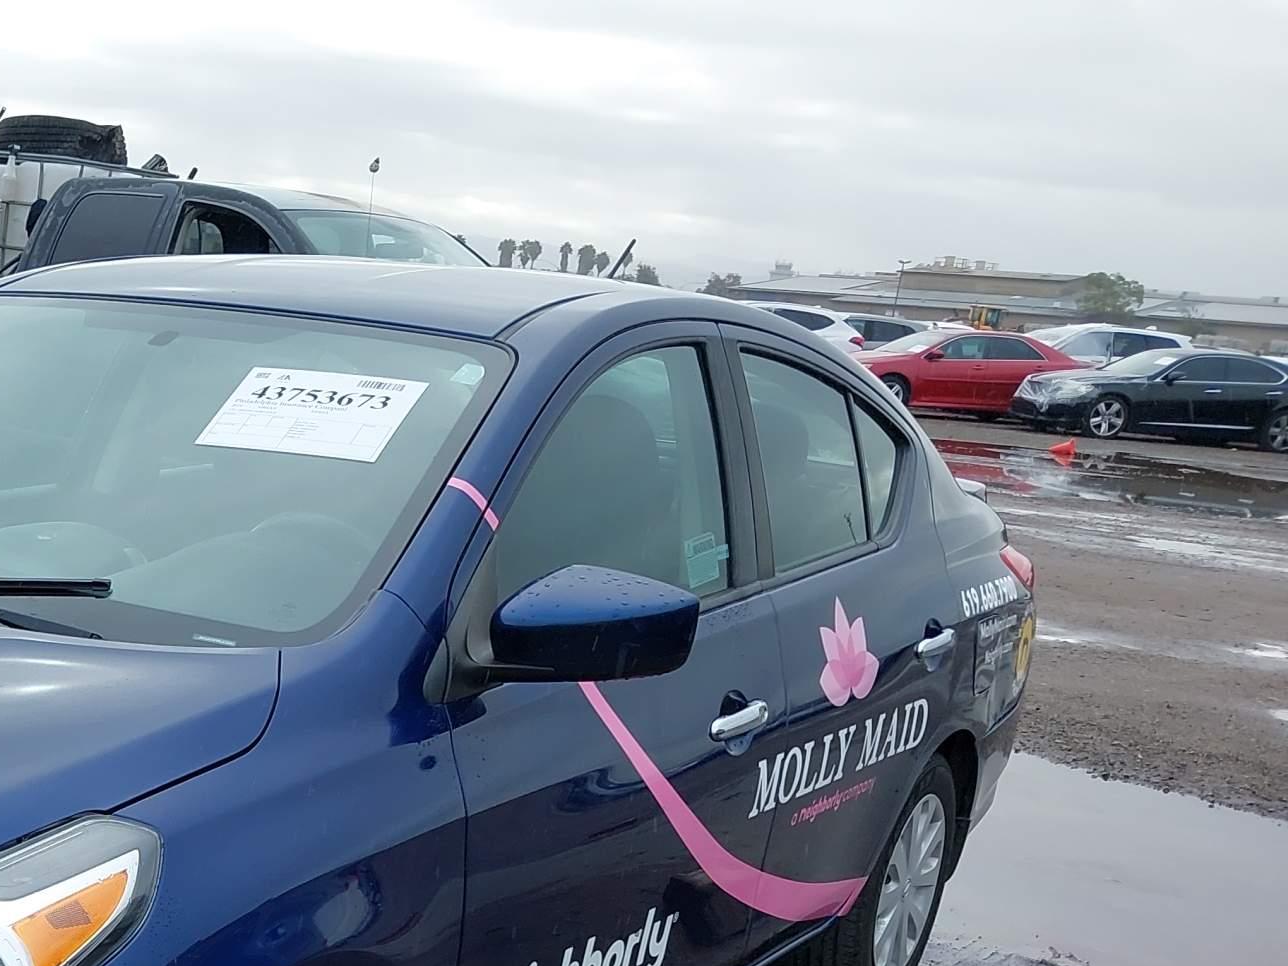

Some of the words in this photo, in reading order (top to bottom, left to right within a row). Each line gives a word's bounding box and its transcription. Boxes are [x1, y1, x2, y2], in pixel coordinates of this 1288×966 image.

[250, 385, 392, 410] 43753673
[748, 724, 857, 819] MOLLY
[855, 698, 929, 772] MAID
[791, 813, 798, 826] a
[798, 789, 843, 823] neighborly
